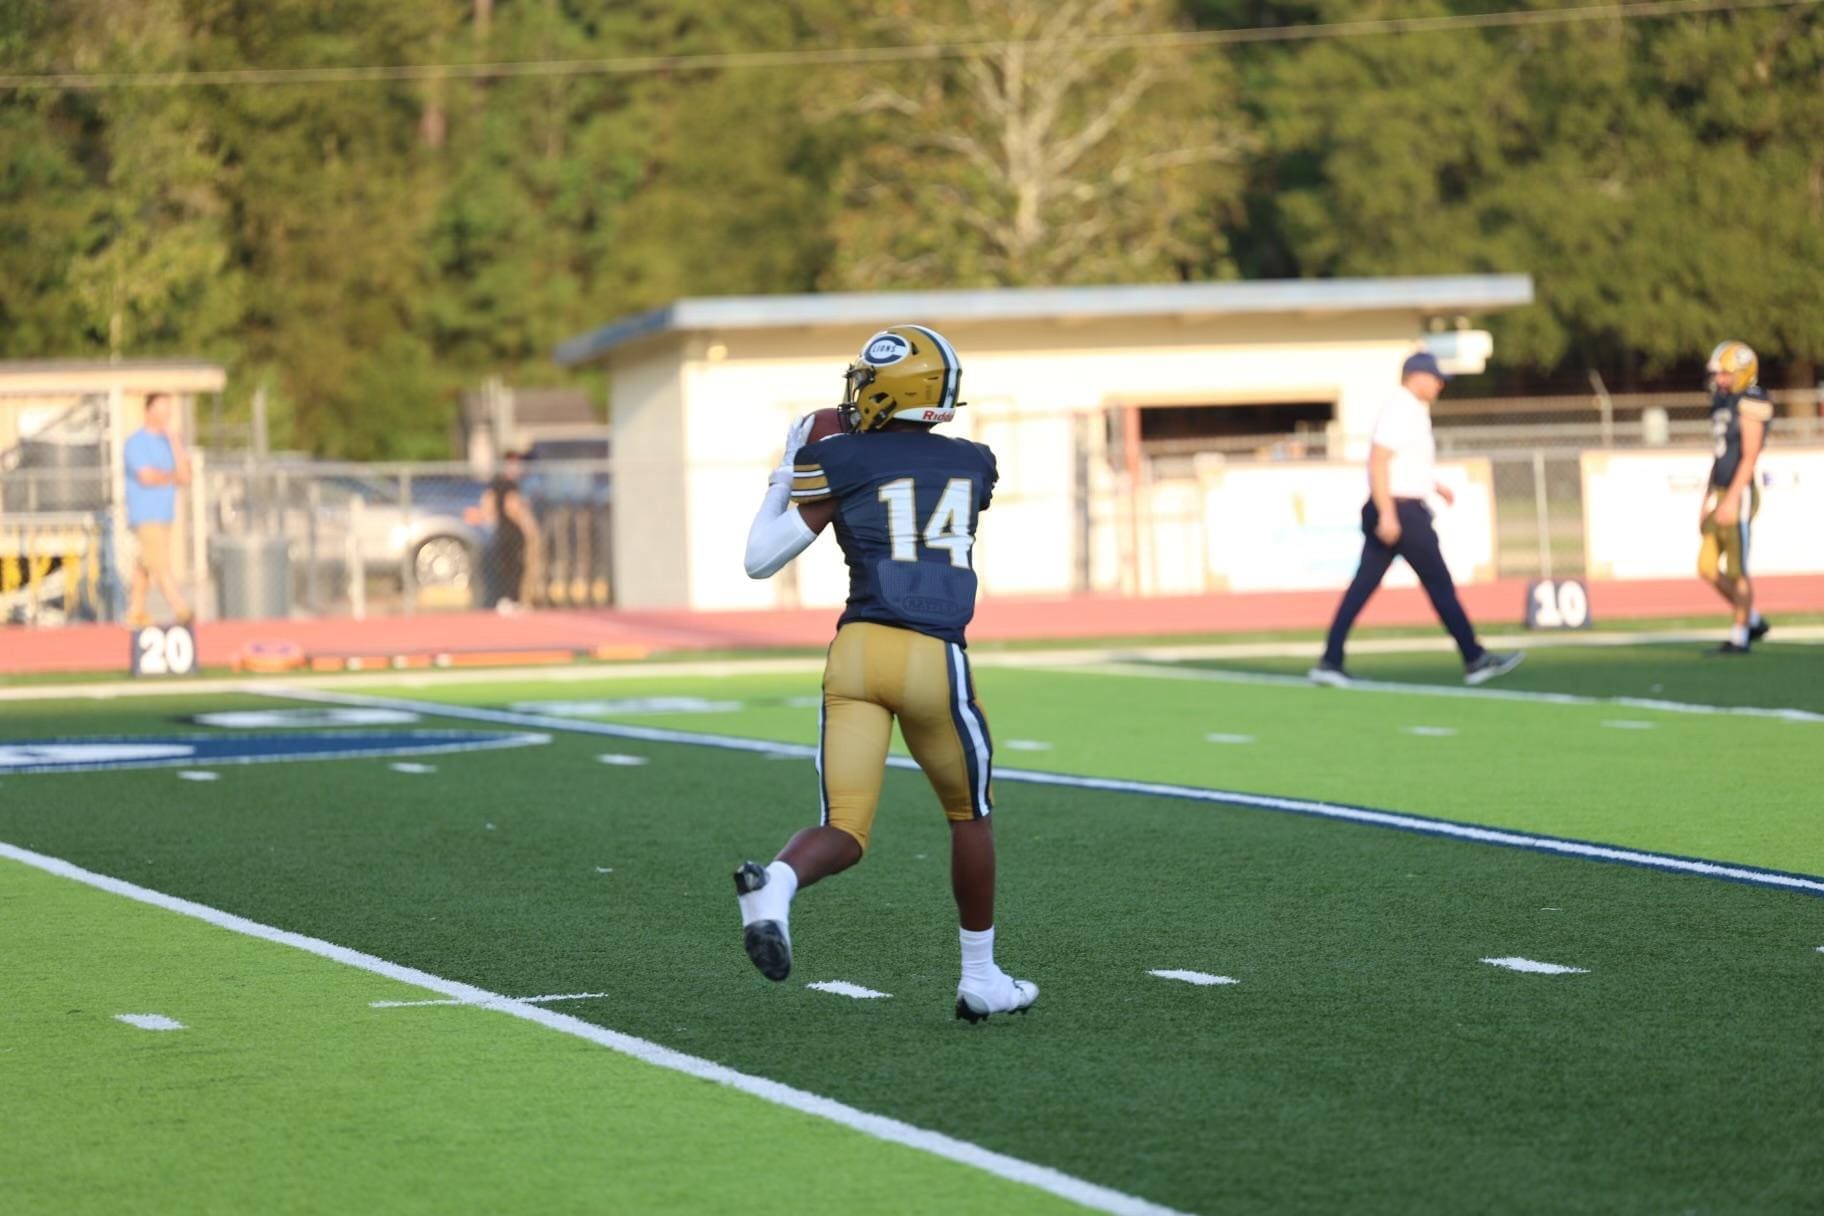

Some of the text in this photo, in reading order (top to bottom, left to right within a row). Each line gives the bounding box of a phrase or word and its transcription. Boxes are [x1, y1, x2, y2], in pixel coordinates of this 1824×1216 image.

[872, 344, 897, 353] LIONS
[878, 477, 976, 570] 14
[1533, 579, 1587, 628] 10
[139, 625, 193, 675] 20
